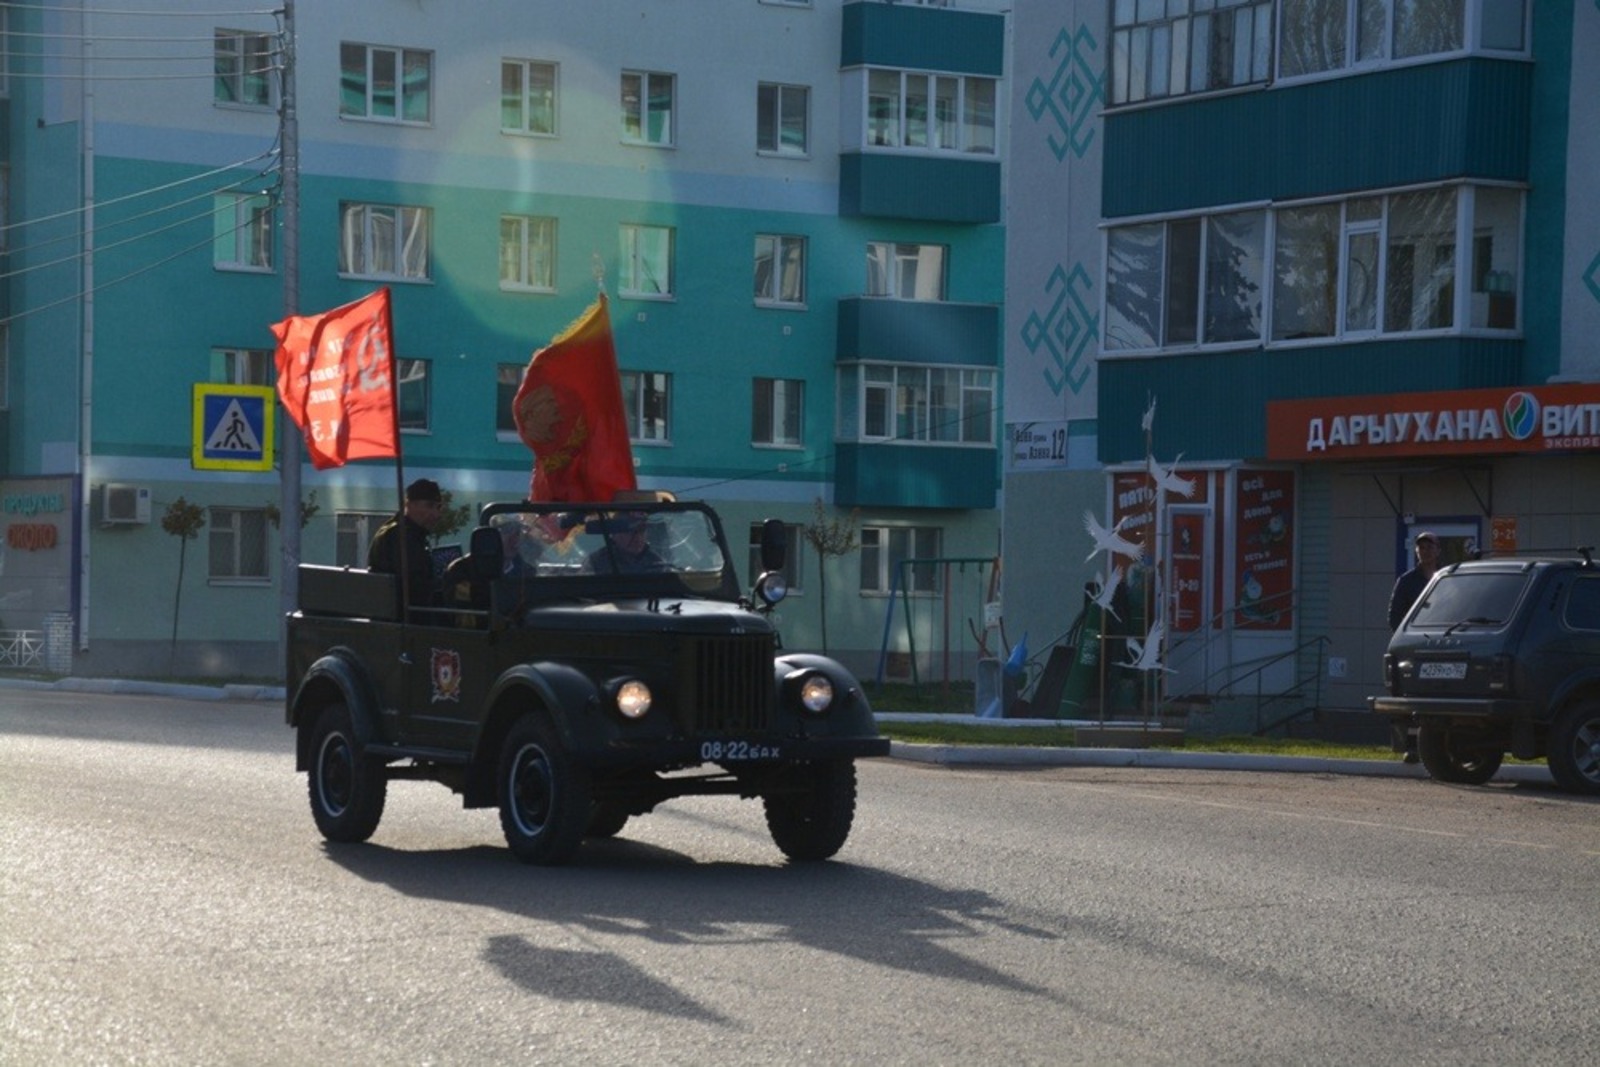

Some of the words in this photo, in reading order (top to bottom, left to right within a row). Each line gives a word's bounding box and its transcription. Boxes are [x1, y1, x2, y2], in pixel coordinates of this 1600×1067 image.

[1051, 428, 1065, 460] 12
[1306, 407, 1503, 452] ДАРЫУХАНА
[4, 493, 64, 516] ПРОДУКТЫ
[7, 523, 57, 552] ОКОЛО
